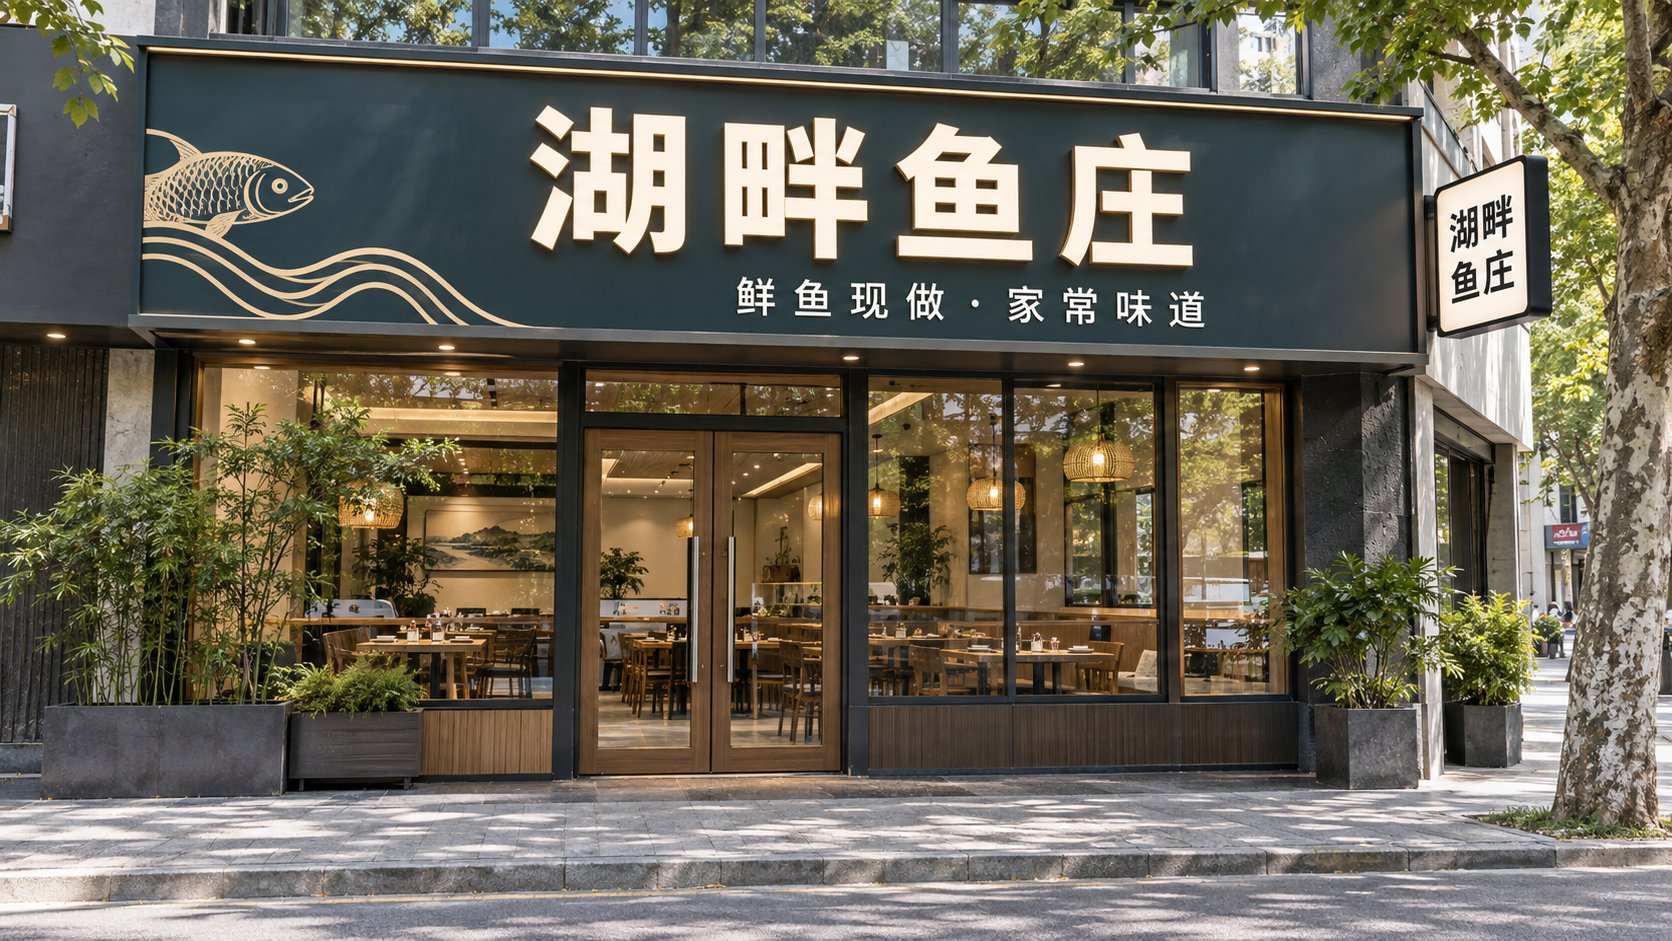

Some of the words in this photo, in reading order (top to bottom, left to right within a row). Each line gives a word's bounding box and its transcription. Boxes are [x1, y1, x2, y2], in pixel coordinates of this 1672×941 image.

[529, 104, 1194, 267] 湖畔鱼庄
[1450, 194, 1513, 253] 湖畔
[736, 276, 1205, 329] 鲜鱼现做·家常味道
[1451, 249, 1514, 304] 鱼庄
